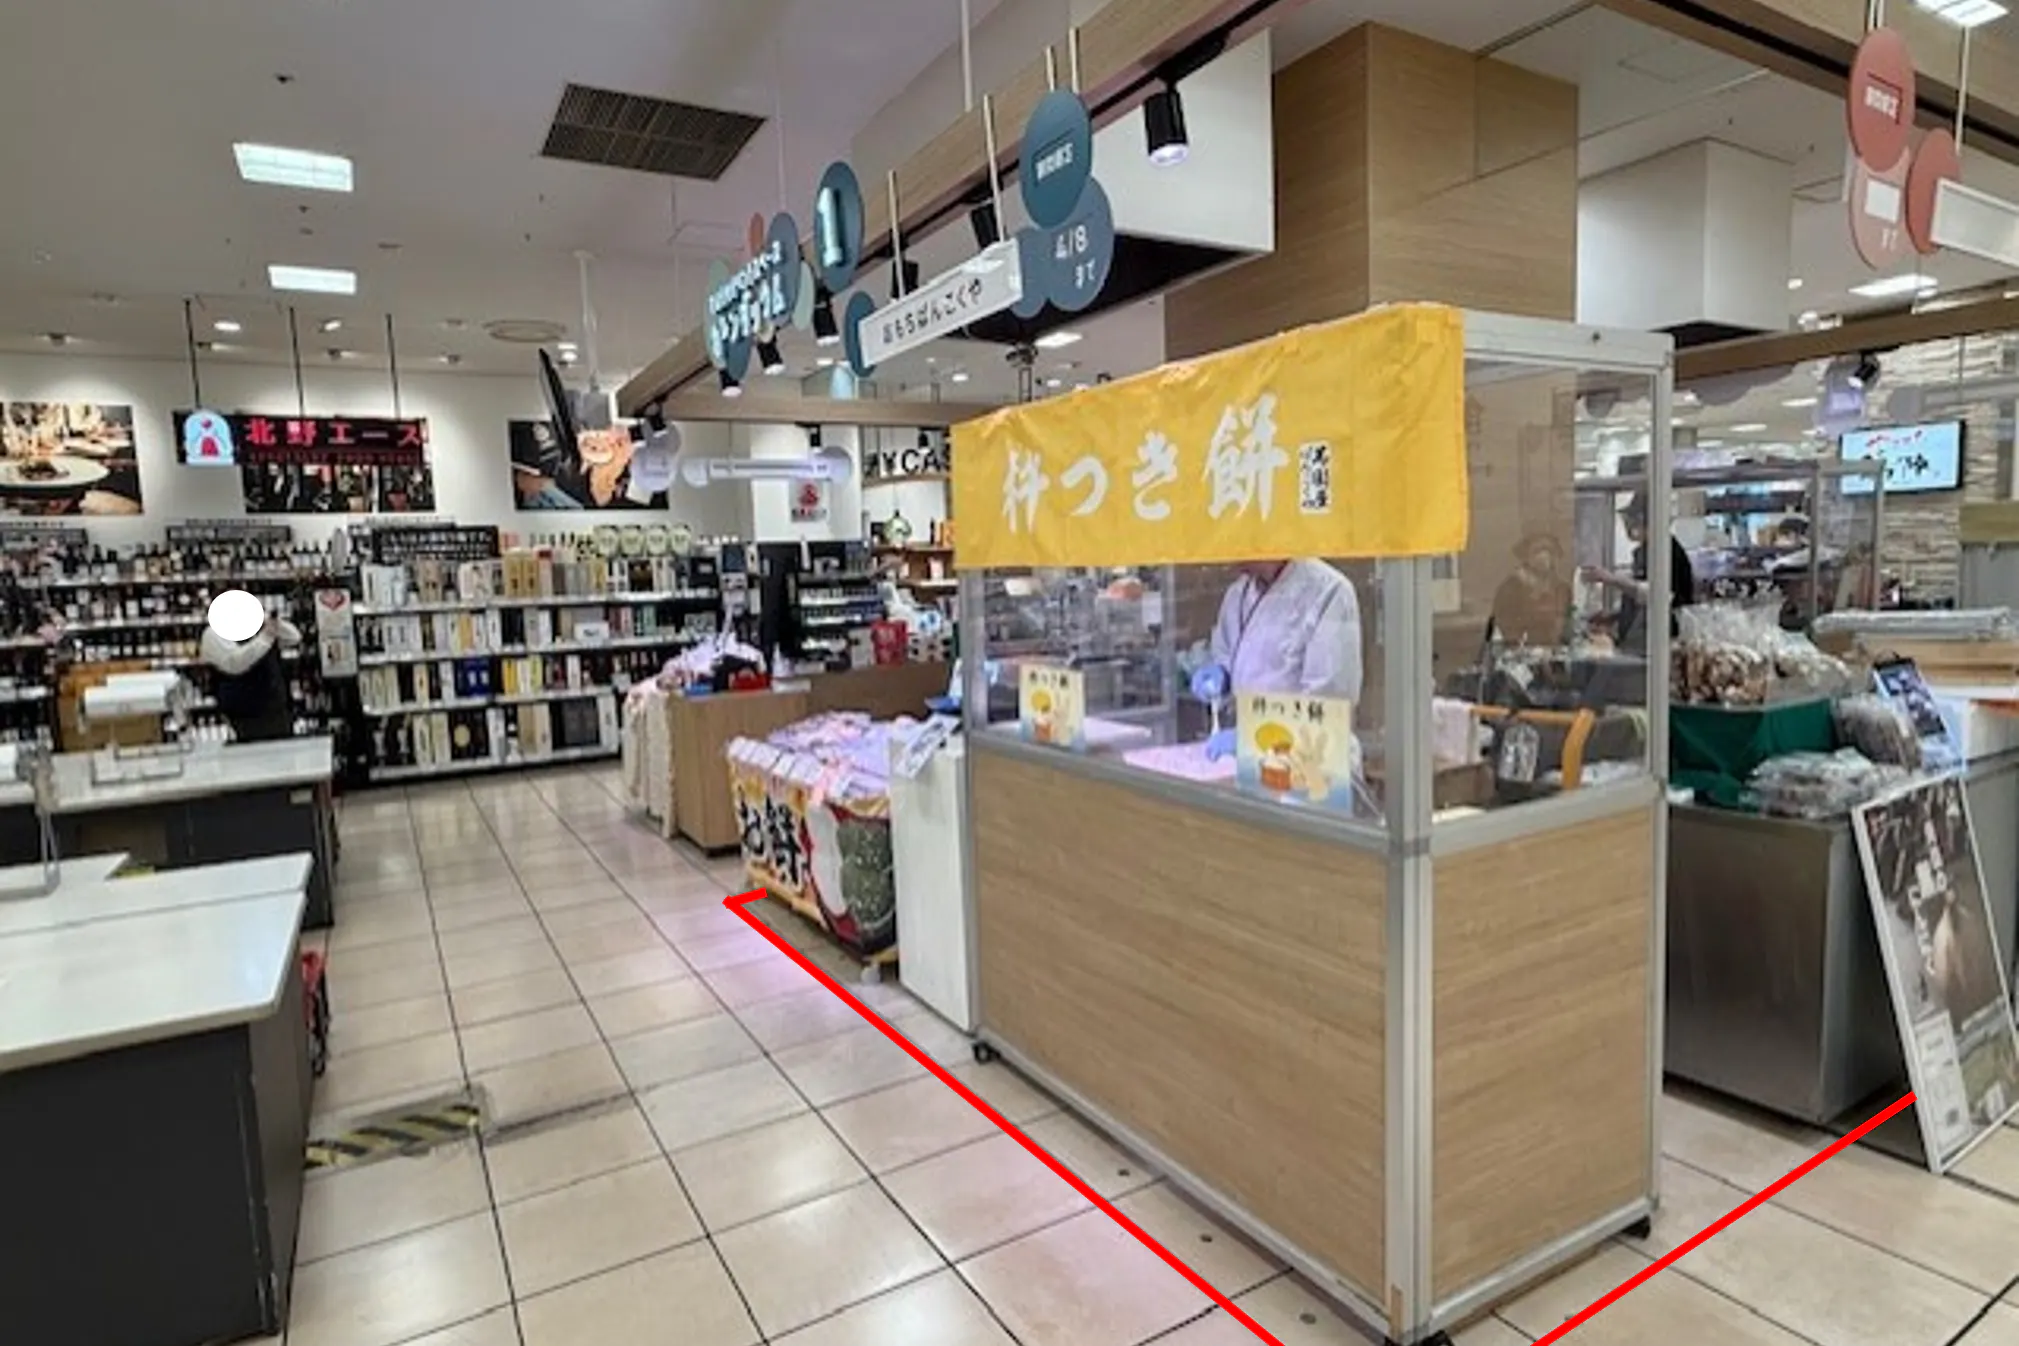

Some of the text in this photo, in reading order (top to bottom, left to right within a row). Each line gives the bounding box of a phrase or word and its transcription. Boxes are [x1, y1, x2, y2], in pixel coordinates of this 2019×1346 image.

[1055, 224, 1089, 259] 4/8
[245, 418, 421, 446] 北野エース
[1002, 393, 1291, 535] 杵つき餅
